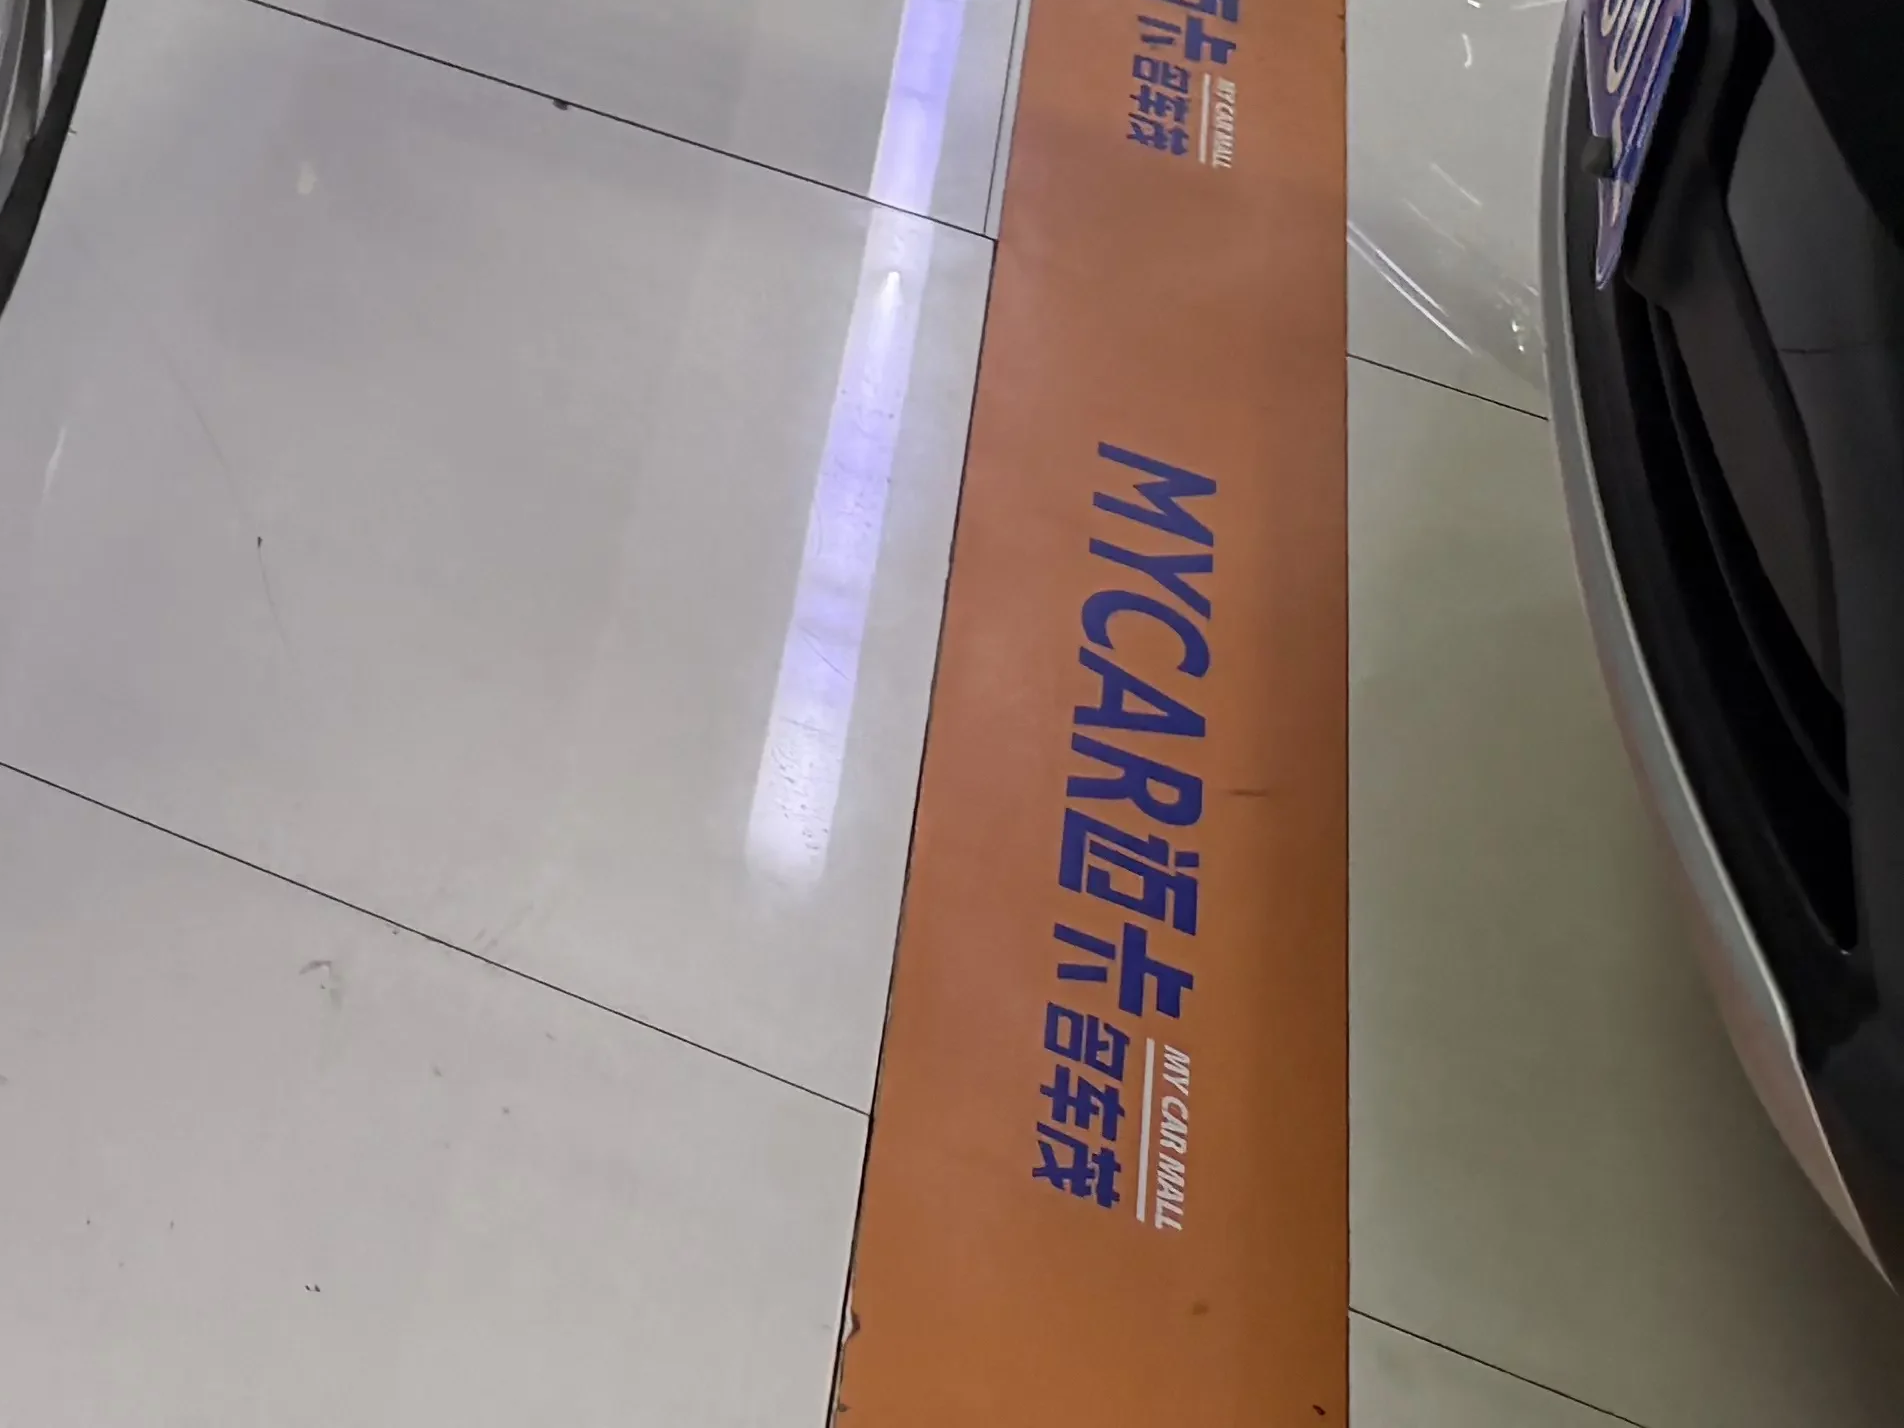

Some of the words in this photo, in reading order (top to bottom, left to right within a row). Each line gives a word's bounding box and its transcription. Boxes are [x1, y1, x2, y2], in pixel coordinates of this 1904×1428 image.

[1162, 1044, 1191, 1097] MY
[1160, 1095, 1189, 1155] CAR
[1154, 1152, 1186, 1231] MALL
